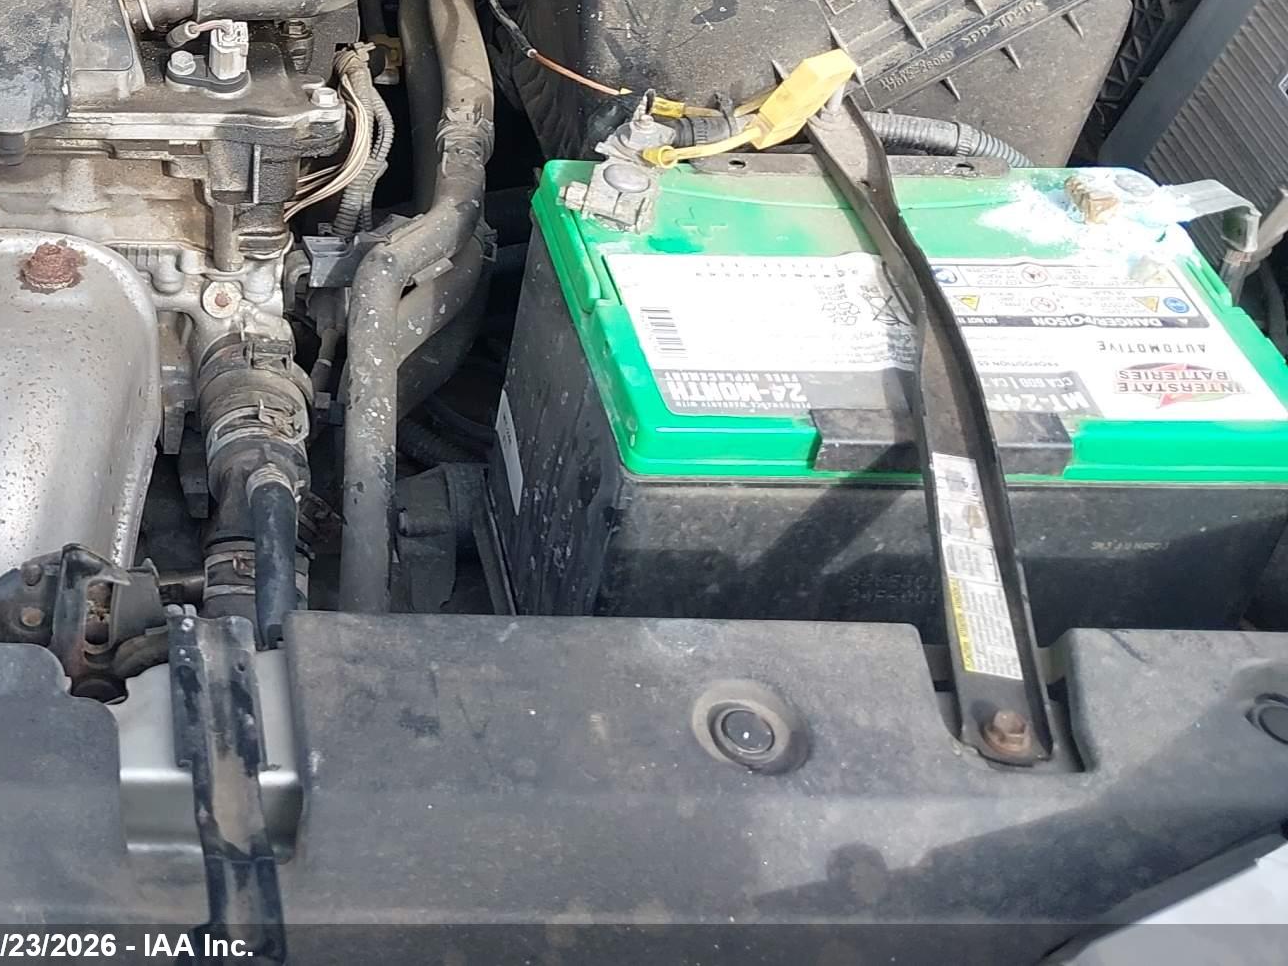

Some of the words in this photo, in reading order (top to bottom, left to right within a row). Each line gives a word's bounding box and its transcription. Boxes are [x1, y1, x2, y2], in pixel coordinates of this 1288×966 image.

[1031, 314, 1163, 327] DANGER/POISON
[1096, 340, 1207, 354] AUTOMOTIVE
[663, 372, 761, 382] REPLACEMENT
[765, 373, 800, 382] FREE
[1118, 370, 1228, 381] BATTERIES
[991, 377, 1008, 387] CA
[1046, 376, 1074, 388] CCA
[1117, 382, 1242, 394] INTERSTATE
[666, 381, 808, 402] 24-MONTH
